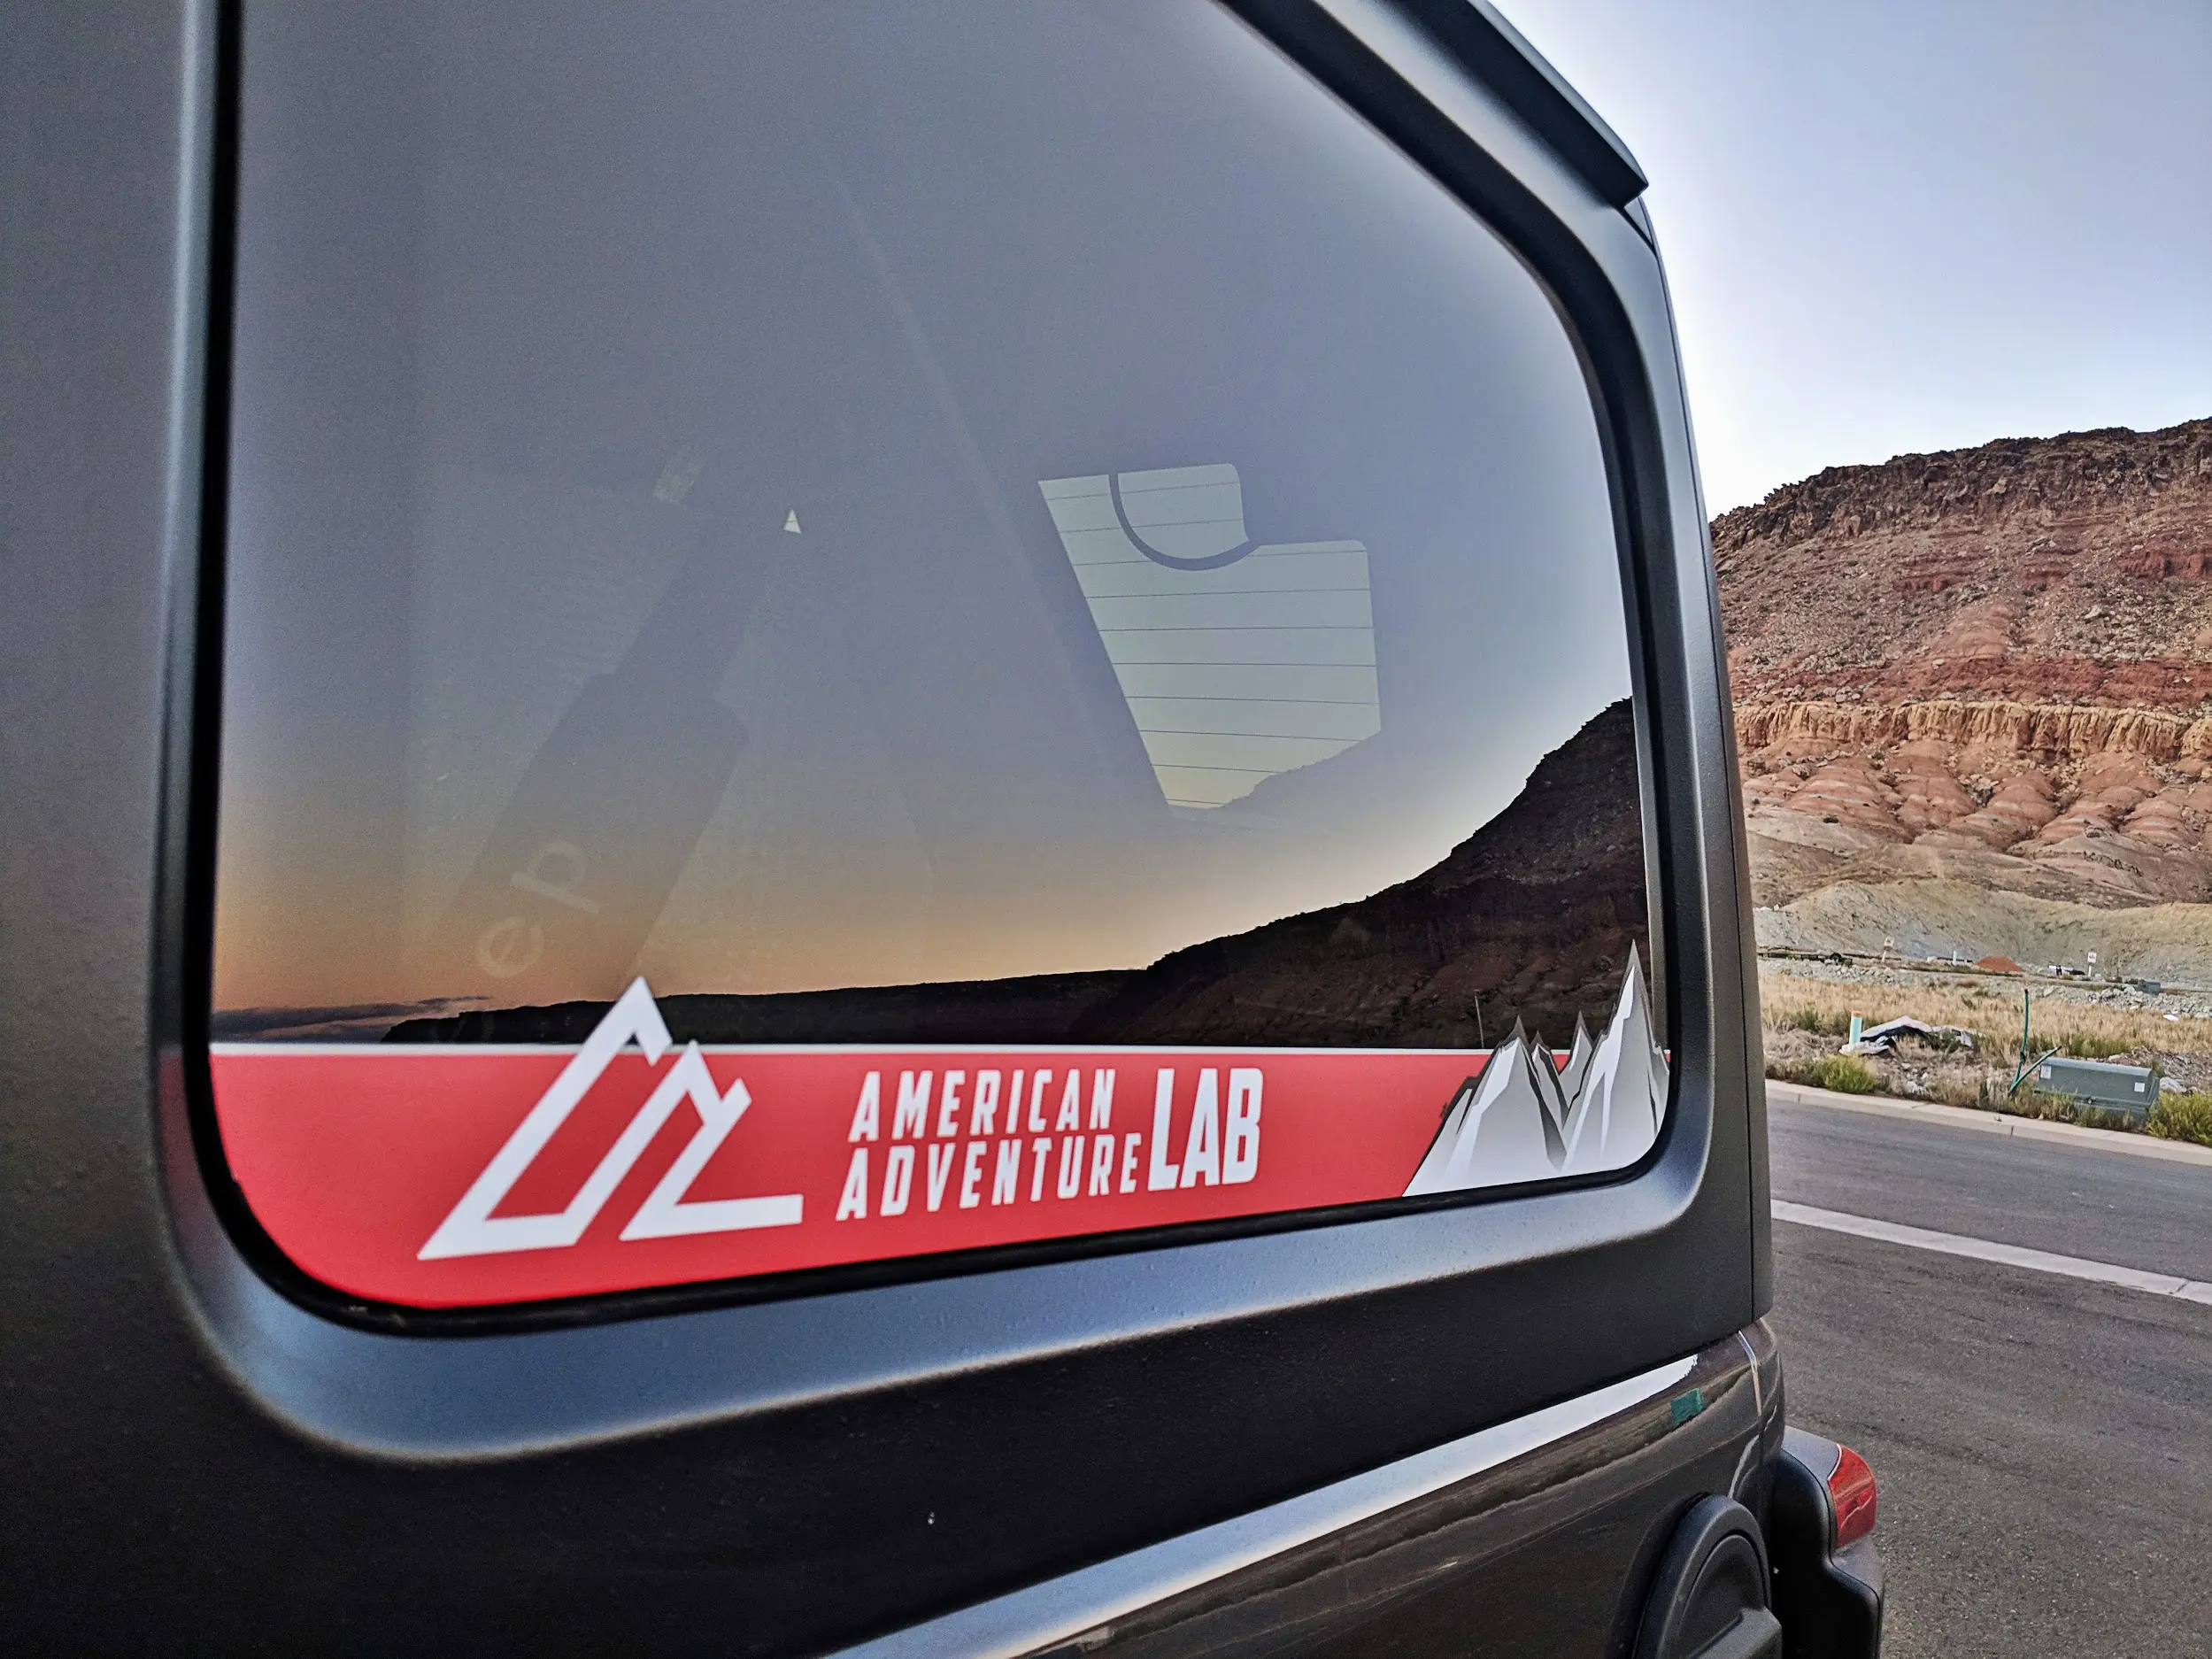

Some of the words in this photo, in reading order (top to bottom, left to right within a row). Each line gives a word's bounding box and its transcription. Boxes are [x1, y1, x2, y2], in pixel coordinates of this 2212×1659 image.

[847, 1069, 1116, 1143] AMERICAN
[1147, 1068, 1265, 1192] LAB
[835, 1132, 1143, 1222] ADVENTURE
